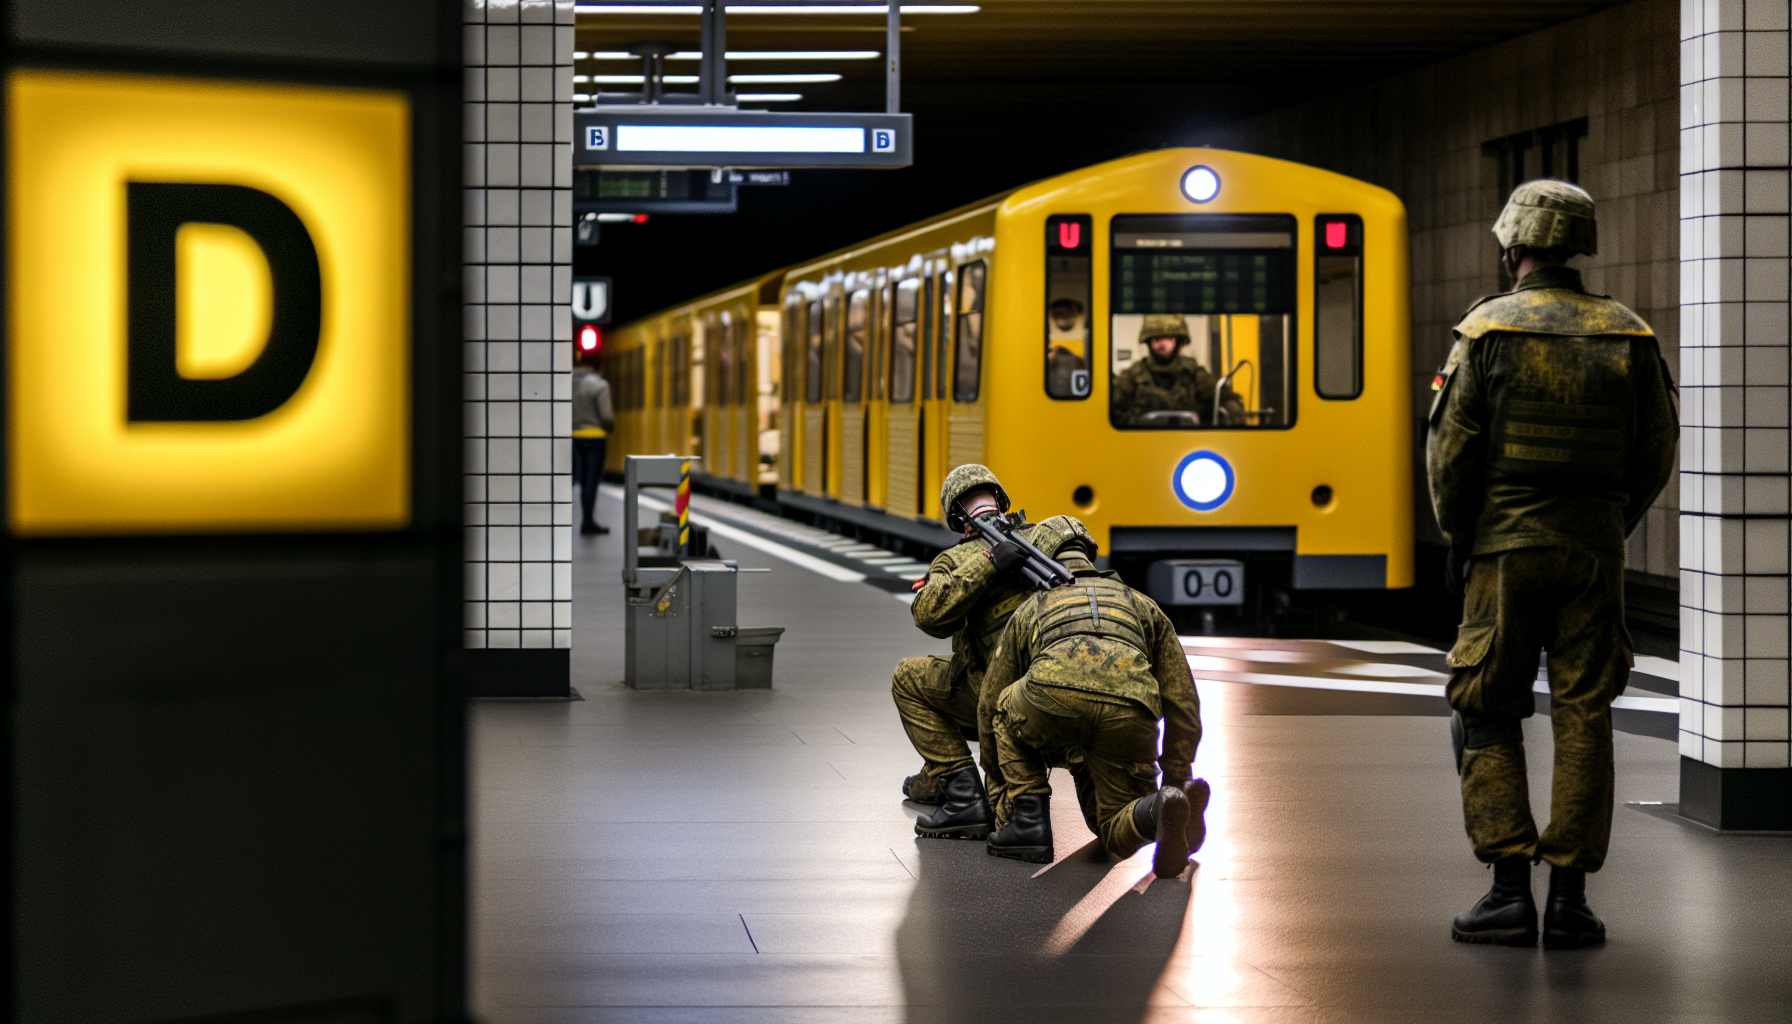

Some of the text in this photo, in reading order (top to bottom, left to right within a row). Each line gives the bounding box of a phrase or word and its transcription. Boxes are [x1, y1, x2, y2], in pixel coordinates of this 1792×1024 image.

[1060, 222, 1080, 248] U
[126, 181, 322, 422] D
[572, 282, 607, 320] U
